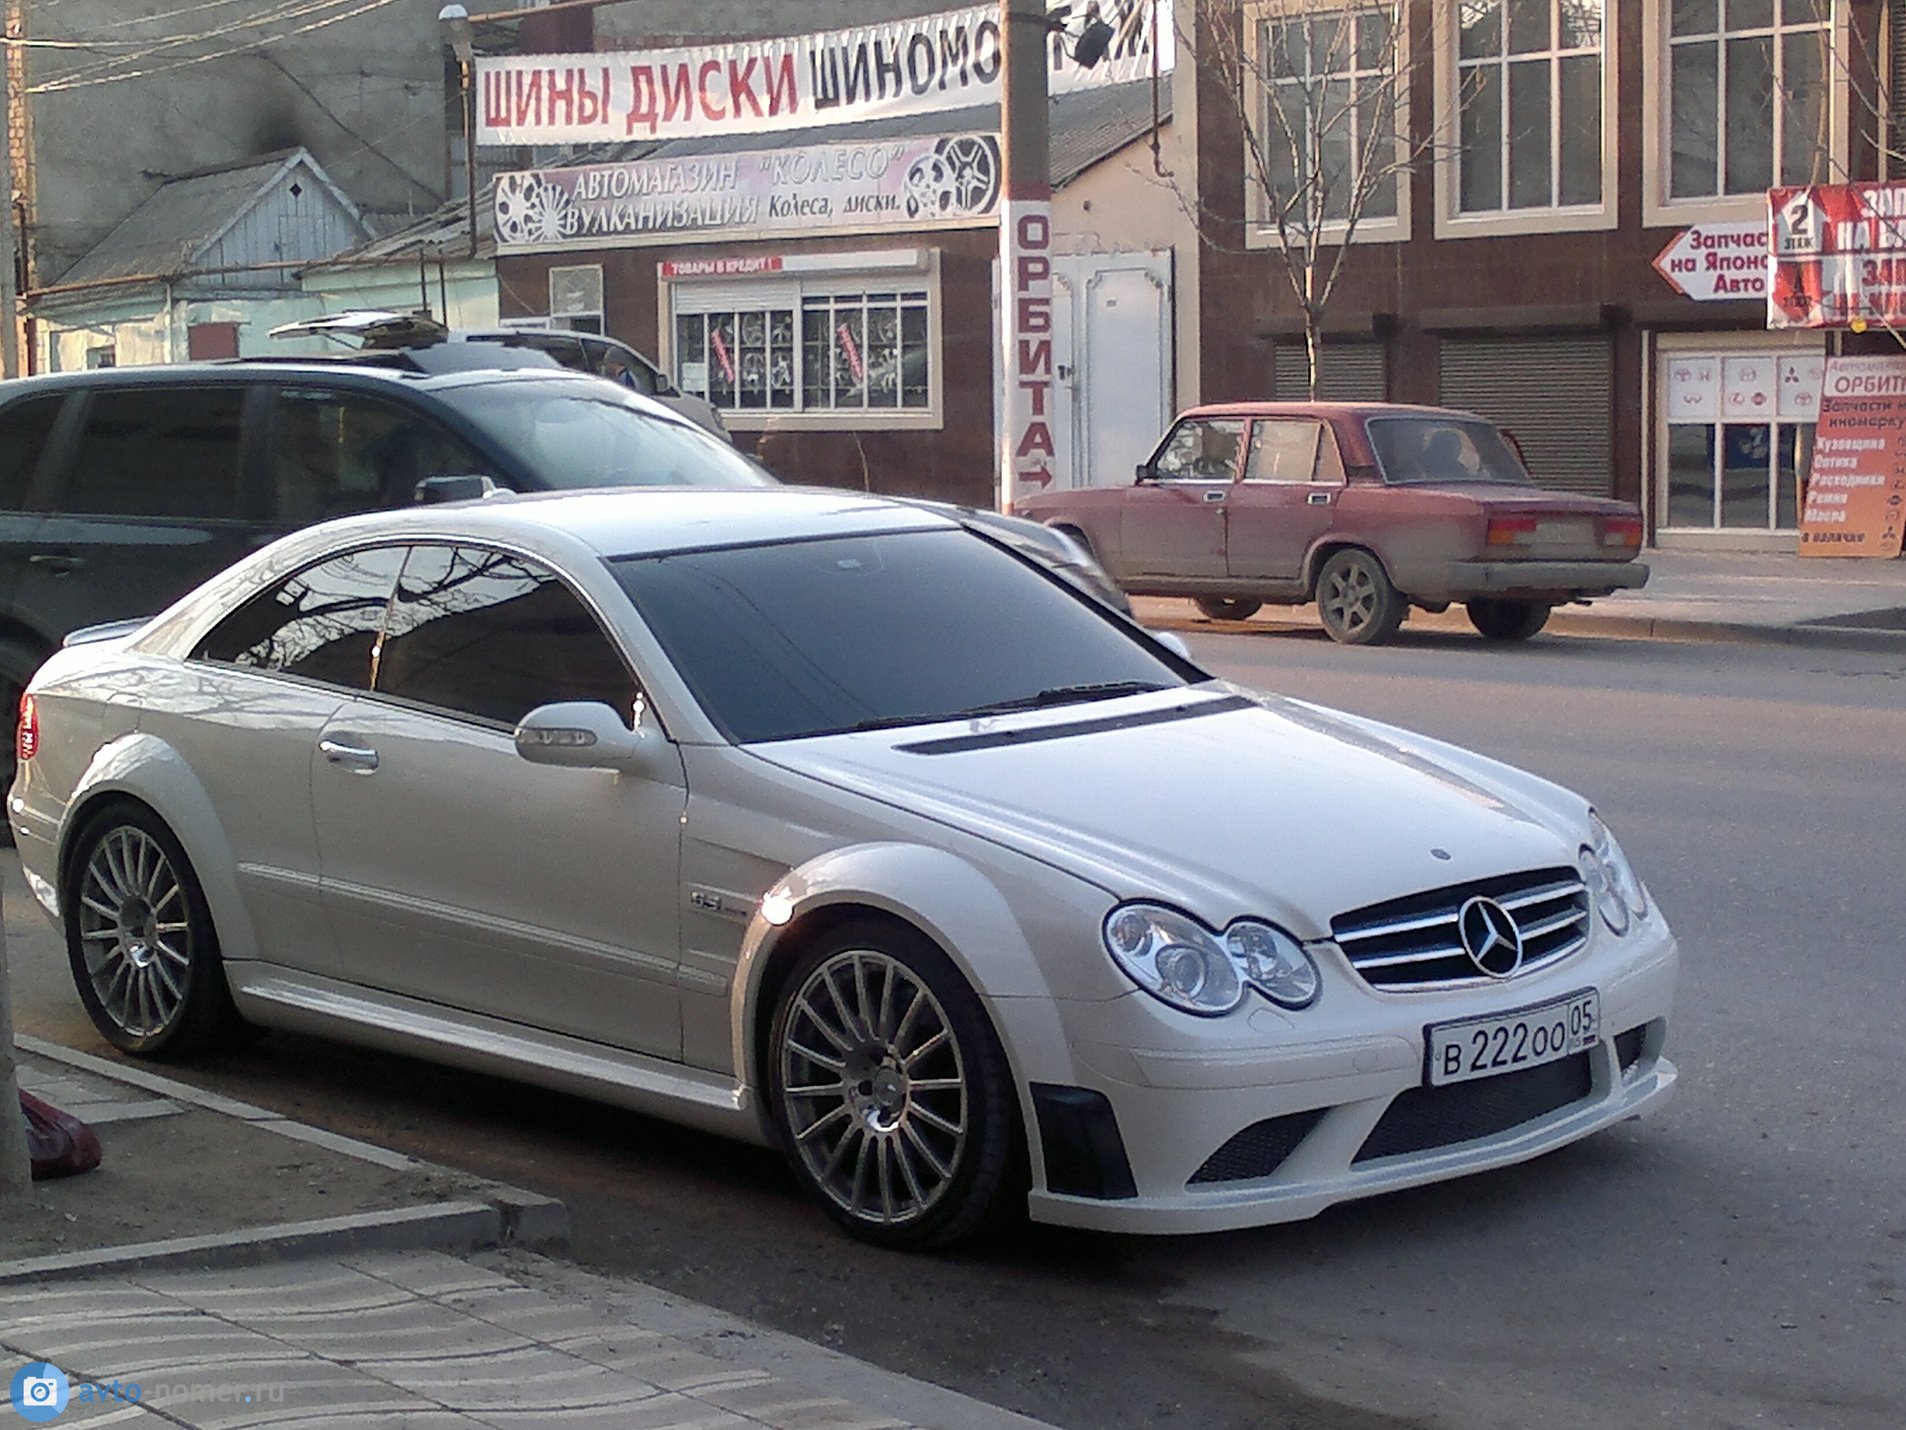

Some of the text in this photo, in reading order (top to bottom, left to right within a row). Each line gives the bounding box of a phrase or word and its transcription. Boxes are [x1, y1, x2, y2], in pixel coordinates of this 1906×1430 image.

[485, 66, 610, 128] ШИНЫ
[626, 54, 798, 135] ДИСКИ
[572, 159, 738, 200] АВТОМАГАЗИН
[565, 195, 760, 235] ВУЛКАНИЗАЦИЯ
[1791, 204, 1808, 235] 2
[1671, 258, 1697, 273] на
[1713, 274, 1765, 294] Авто
[1016, 214, 1055, 457] ОРБИТА
